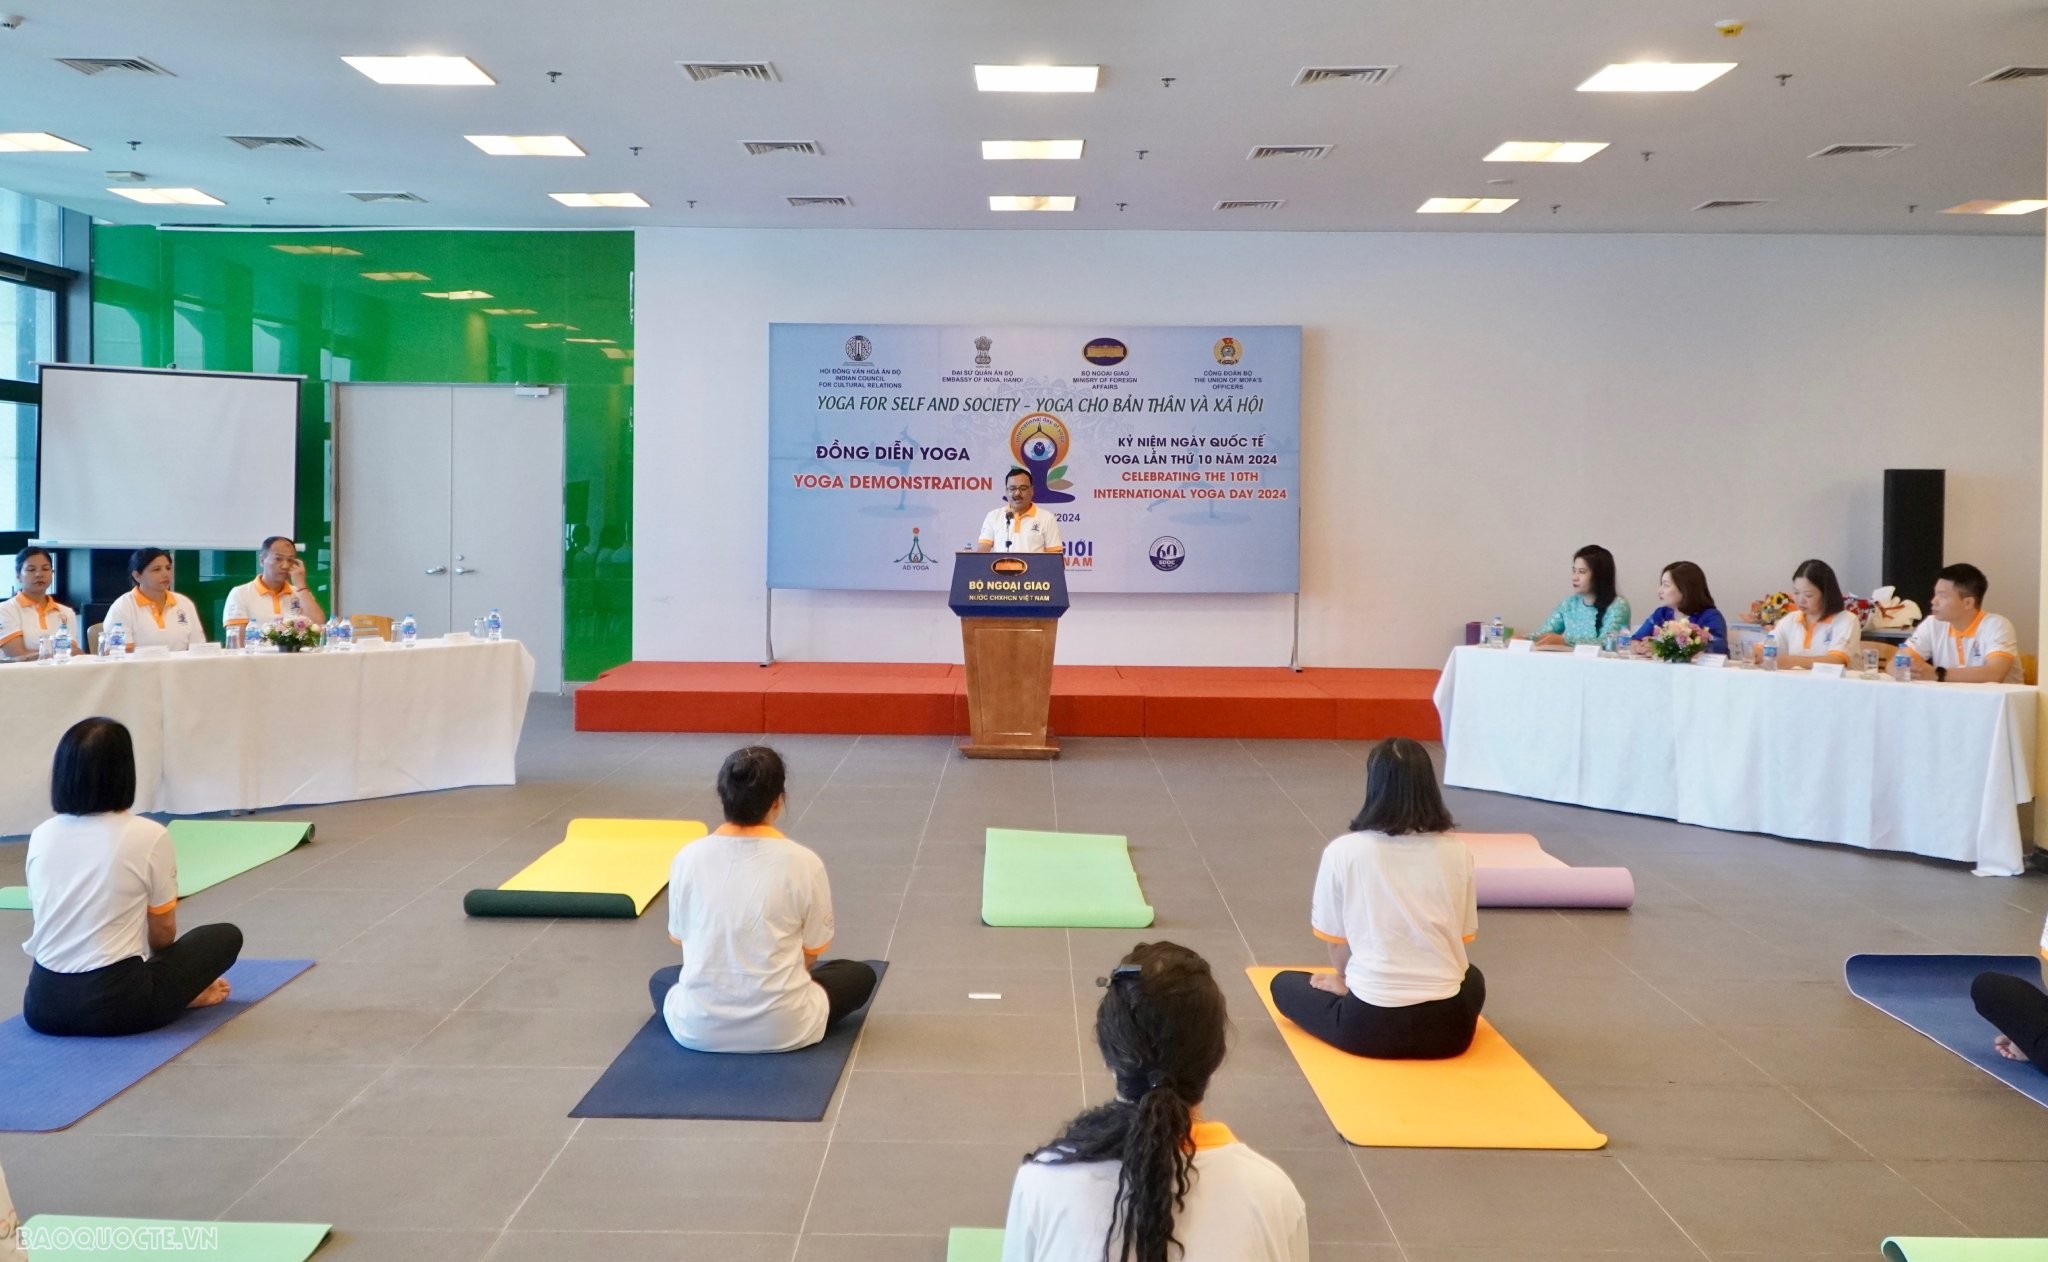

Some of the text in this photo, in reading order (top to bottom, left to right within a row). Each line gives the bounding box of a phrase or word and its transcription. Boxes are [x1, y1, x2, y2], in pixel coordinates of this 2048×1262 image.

[818, 395, 855, 410] YOGA
[860, 396, 888, 410] FOR
[891, 397, 926, 411] SELF
[926, 397, 960, 411] AND
[962, 397, 1021, 412] SOCIETY
[1036, 398, 1074, 412] YOGA
[1078, 397, 1109, 412] CHO
[1112, 394, 1144, 412] BẢN
[1147, 395, 1186, 413] THÂN
[1190, 394, 1208, 412] VÀ
[1213, 395, 1233, 412] XÃ
[1236, 395, 1264, 415] HỘI
[1118, 434, 1133, 447] KỶ
[1171, 435, 1206, 447] NGÀY
[1210, 433, 1248, 447] QUỐC
[1252, 433, 1266, 447] TẾ
[816, 439, 970, 461] ĐỒNG DIỄN YOGA
[1104, 455, 1140, 464] YOGA
[1171, 452, 1194, 464] THỨ
[1199, 455, 1212, 464] 10
[1216, 453, 1244, 464] NĂM
[1248, 455, 1278, 464] 2024
[793, 475, 993, 490] YOGA DEMONSTRATION
[1122, 472, 1259, 481] CELEBRATING THE 10TH
[1093, 489, 1287, 499] INTERNATIONAL YOGA DAY 2024
[969, 579, 1051, 592] BỘ NGOẠI GIAO
